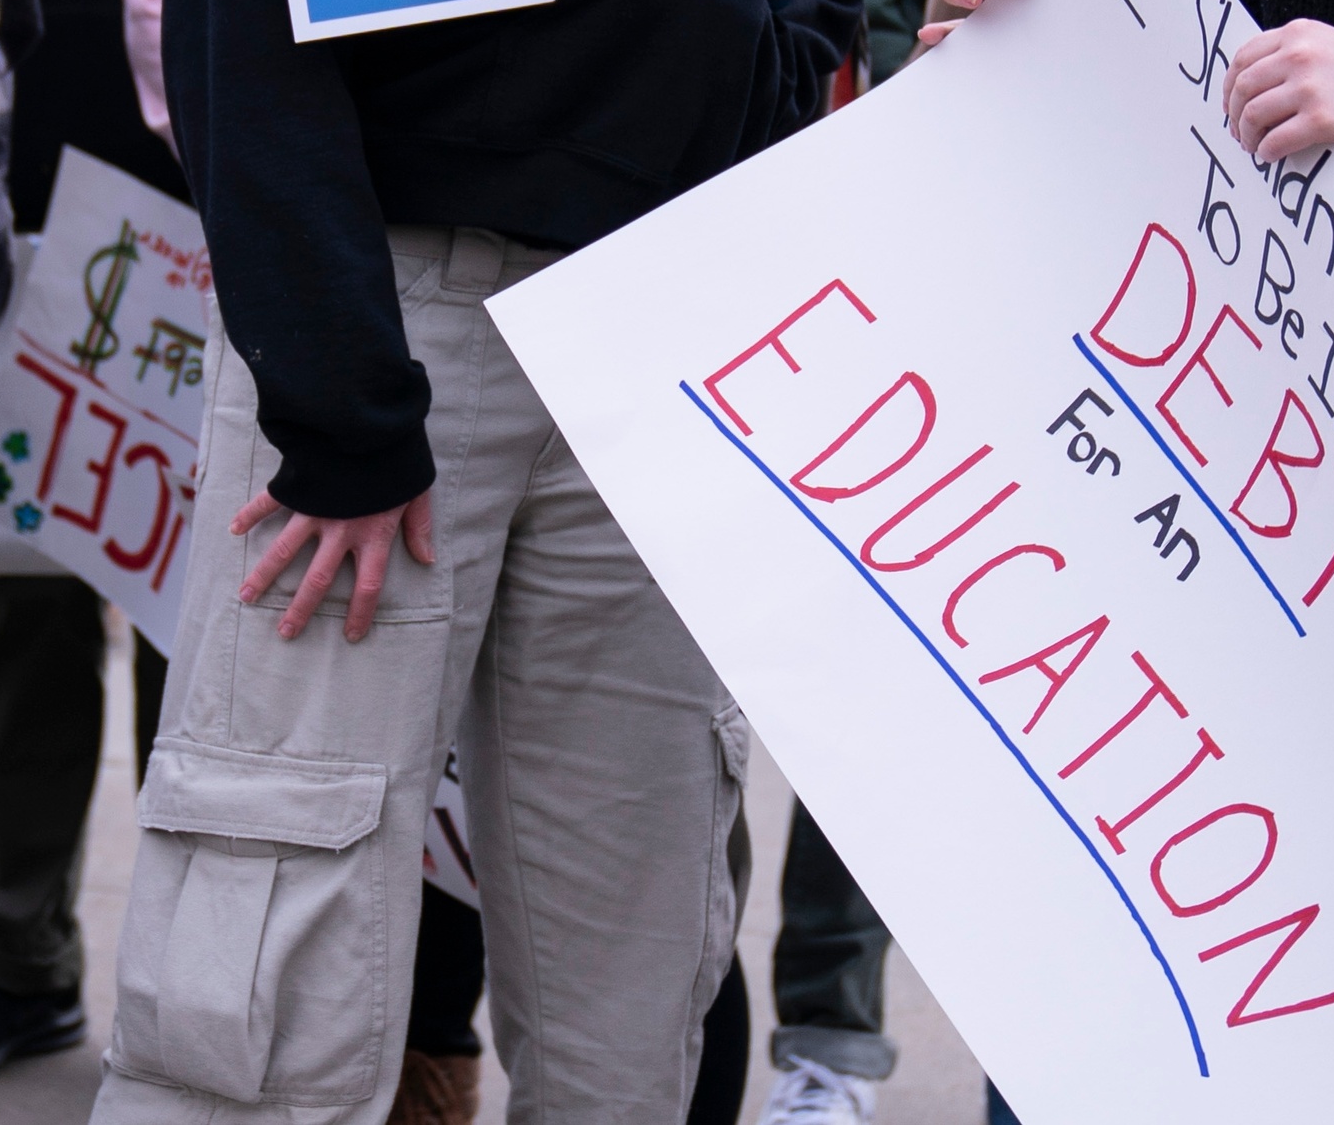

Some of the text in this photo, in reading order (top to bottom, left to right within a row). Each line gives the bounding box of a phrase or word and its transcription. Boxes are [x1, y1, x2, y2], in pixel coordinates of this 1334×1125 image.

[1189, 124, 1242, 266] To
[1254, 227, 1306, 361] Be
[1045, 388, 1201, 583] For An
